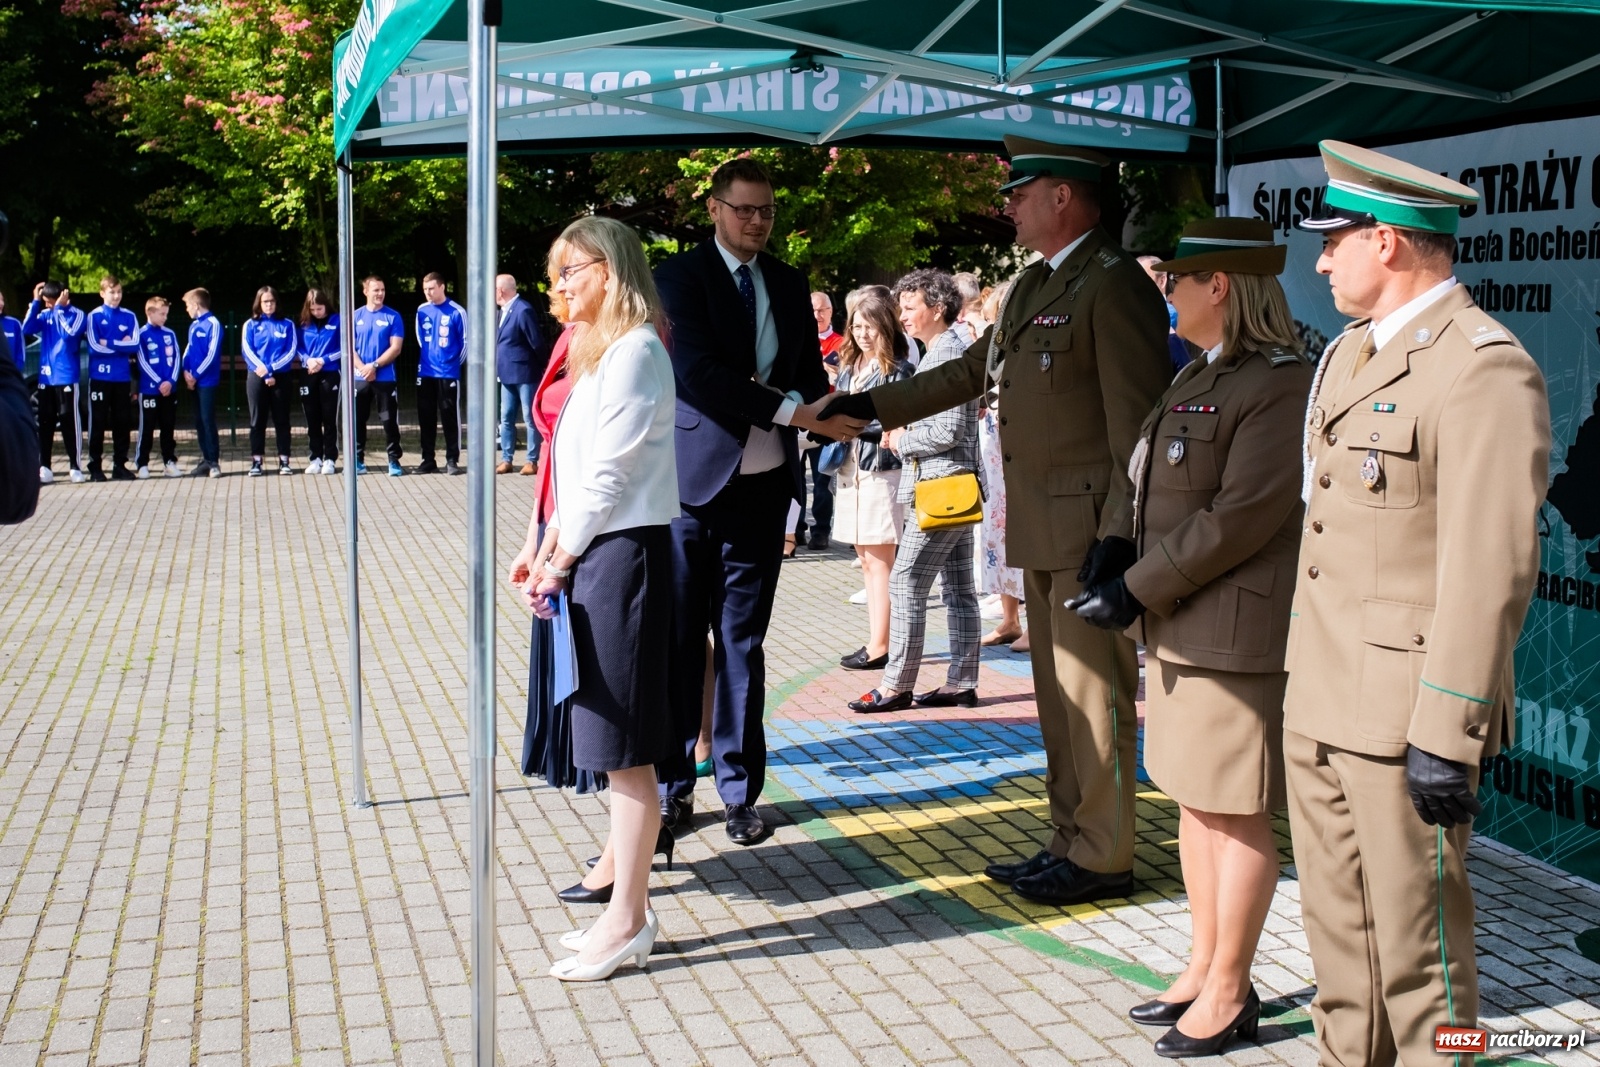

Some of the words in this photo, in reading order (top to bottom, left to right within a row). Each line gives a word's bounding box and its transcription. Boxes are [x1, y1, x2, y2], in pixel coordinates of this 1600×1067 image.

[1253, 182, 1329, 237] ŚLĄSK
[1459, 149, 1582, 218] STRAŻY
[1509, 222, 1600, 262] Bocheń
[98, 364, 111, 373] 61
[91, 391, 104, 401] 61
[143, 399, 156, 409] 66
[1537, 571, 1600, 613] RACIB
[1479, 753, 1576, 821] POLISH
